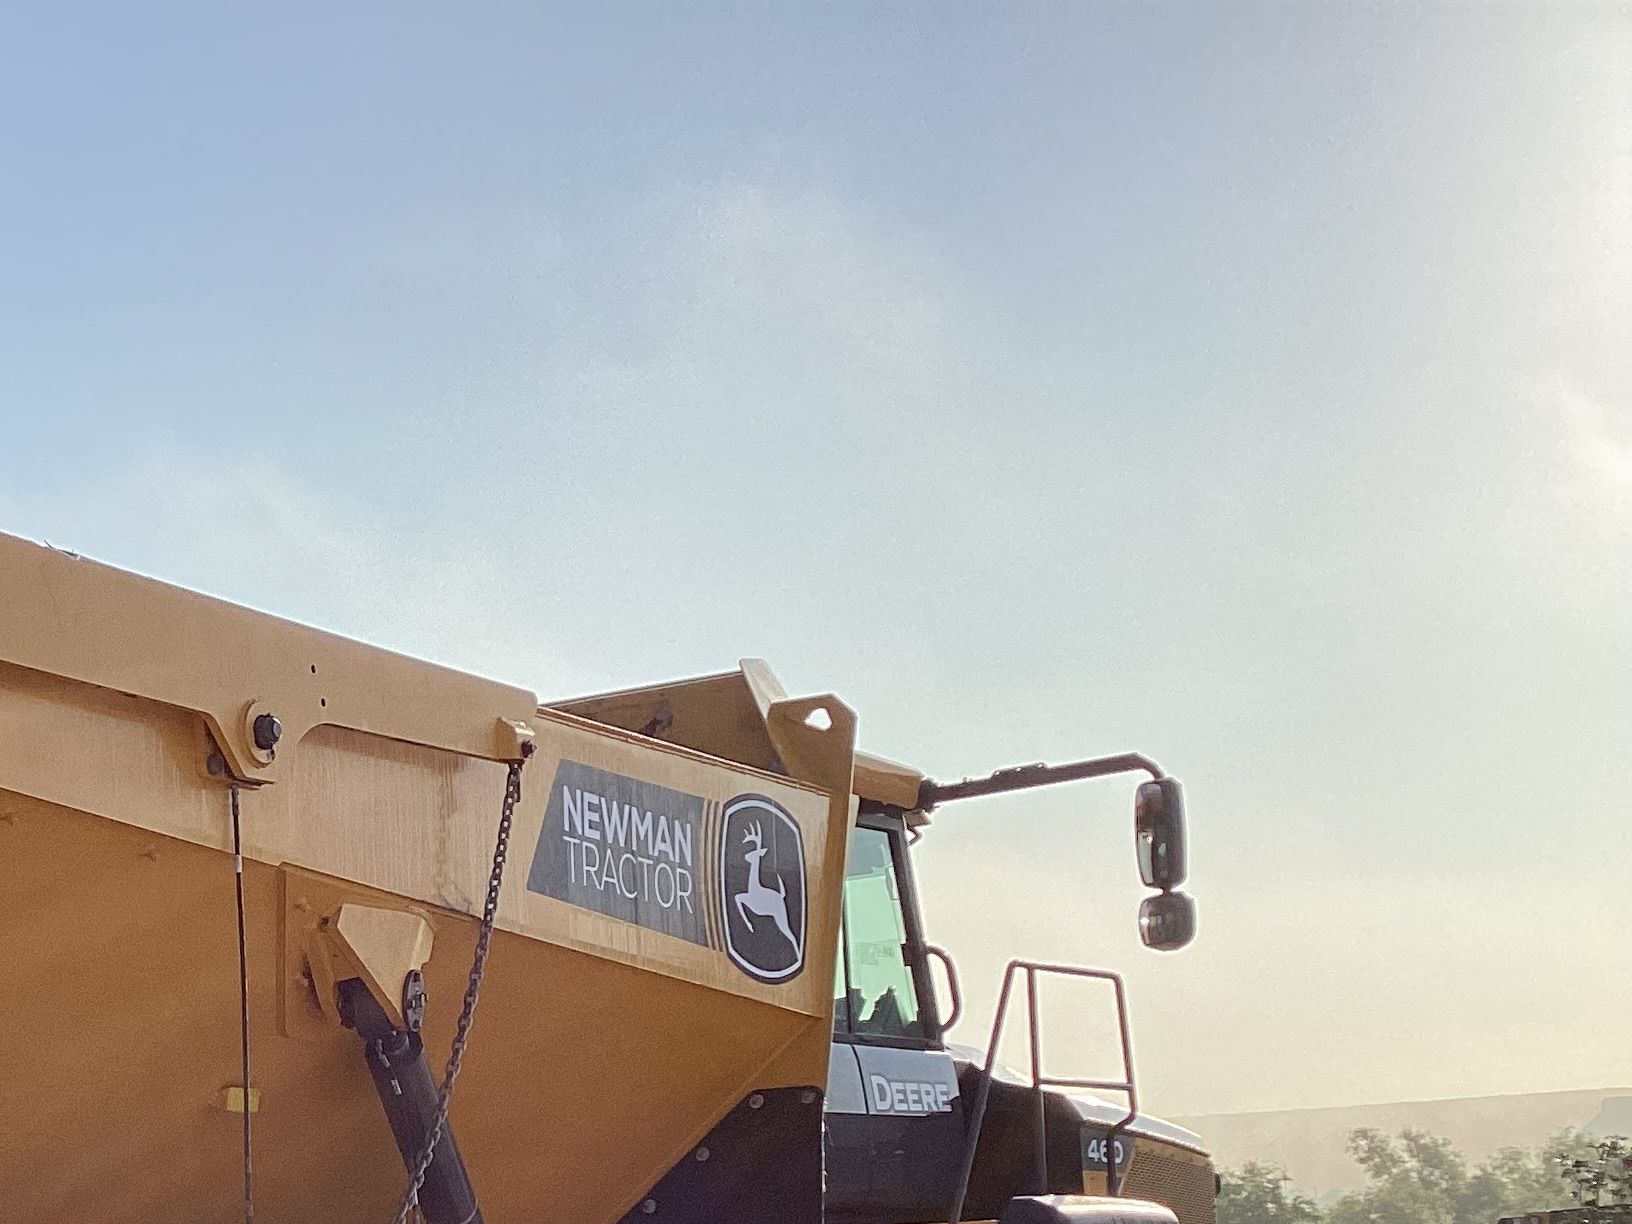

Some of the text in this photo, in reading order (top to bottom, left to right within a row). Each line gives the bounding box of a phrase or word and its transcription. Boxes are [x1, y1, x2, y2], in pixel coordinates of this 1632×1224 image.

[563, 785, 692, 866] NEWMAN
[562, 836, 693, 914] TRACTOR
[870, 1074, 952, 1112] DEERE
